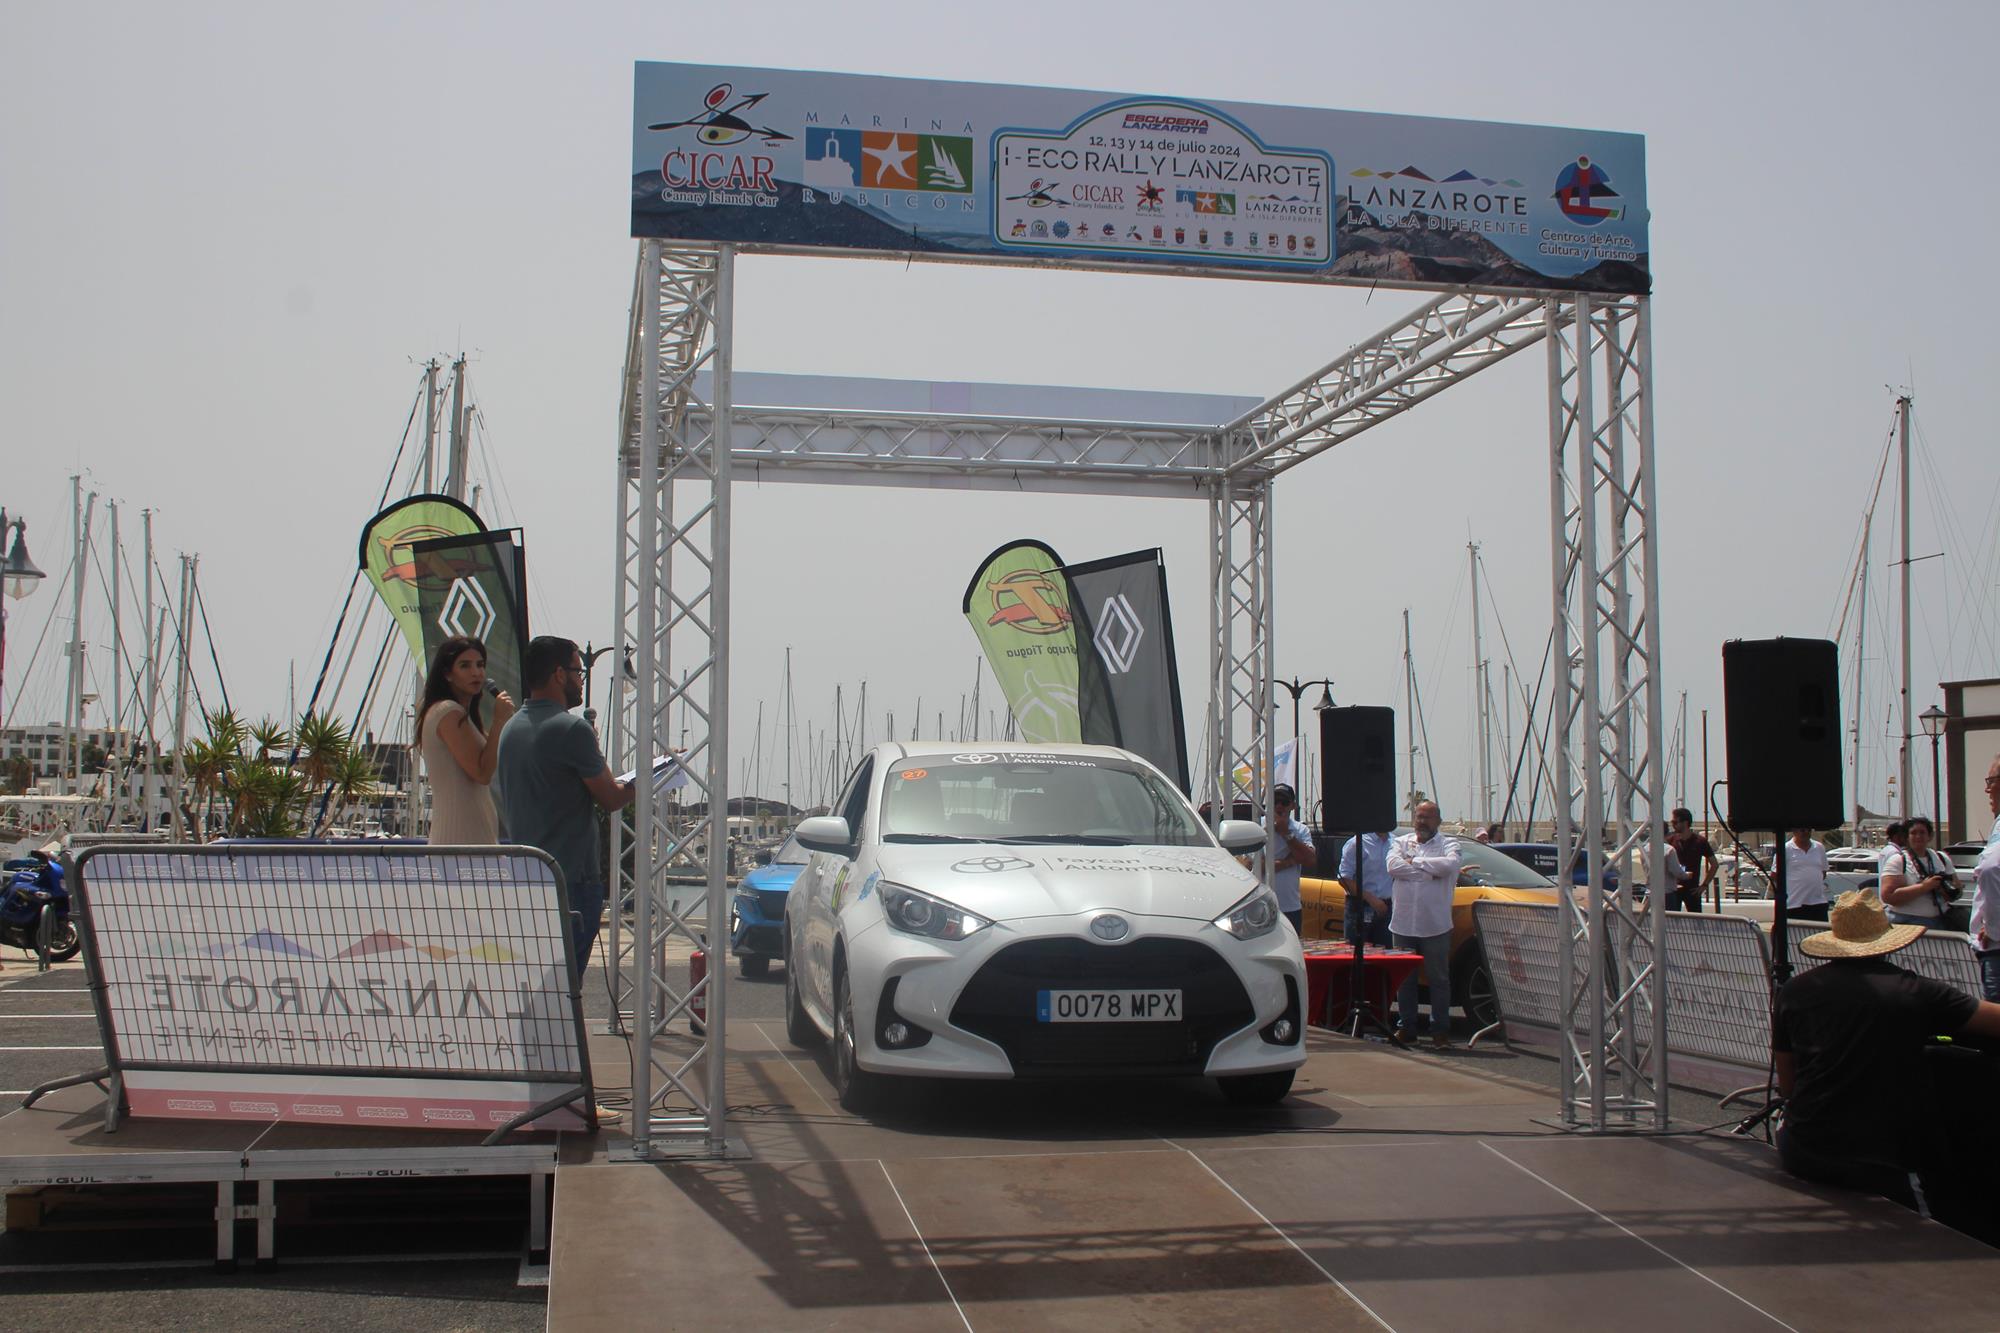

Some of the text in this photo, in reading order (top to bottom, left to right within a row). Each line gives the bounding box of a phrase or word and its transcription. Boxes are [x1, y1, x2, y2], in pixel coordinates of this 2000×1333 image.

[805, 111, 973, 133] MARINA
[1122, 121, 1208, 134] LANZAROTE
[1125, 114, 1208, 127] ESCUDERIA
[1089, 136, 1240, 157] 12, 13 y 14 de julio 2024
[661, 151, 777, 192] CICAR
[1173, 158, 1321, 187] LANZAROTE
[662, 189, 779, 207] Canary Islands Car
[802, 189, 975, 212] RUBICÓN
[1072, 183, 1124, 203] CICAR
[1347, 185, 1528, 216] LANZAROTE
[1245, 202, 1323, 216] LANZAROTE
[1347, 210, 1529, 235] LA ISLA DIFERENTE
[1541, 229, 1634, 249] Centros de Arte,
[1538, 243, 1637, 262] Cultura y Turismo
[1057, 857, 1140, 865] Faycan
[1065, 864, 1216, 878] Automoción
[1058, 994, 1177, 1018] 0078 MPX
[56, 1176, 103, 1184] GUIL
